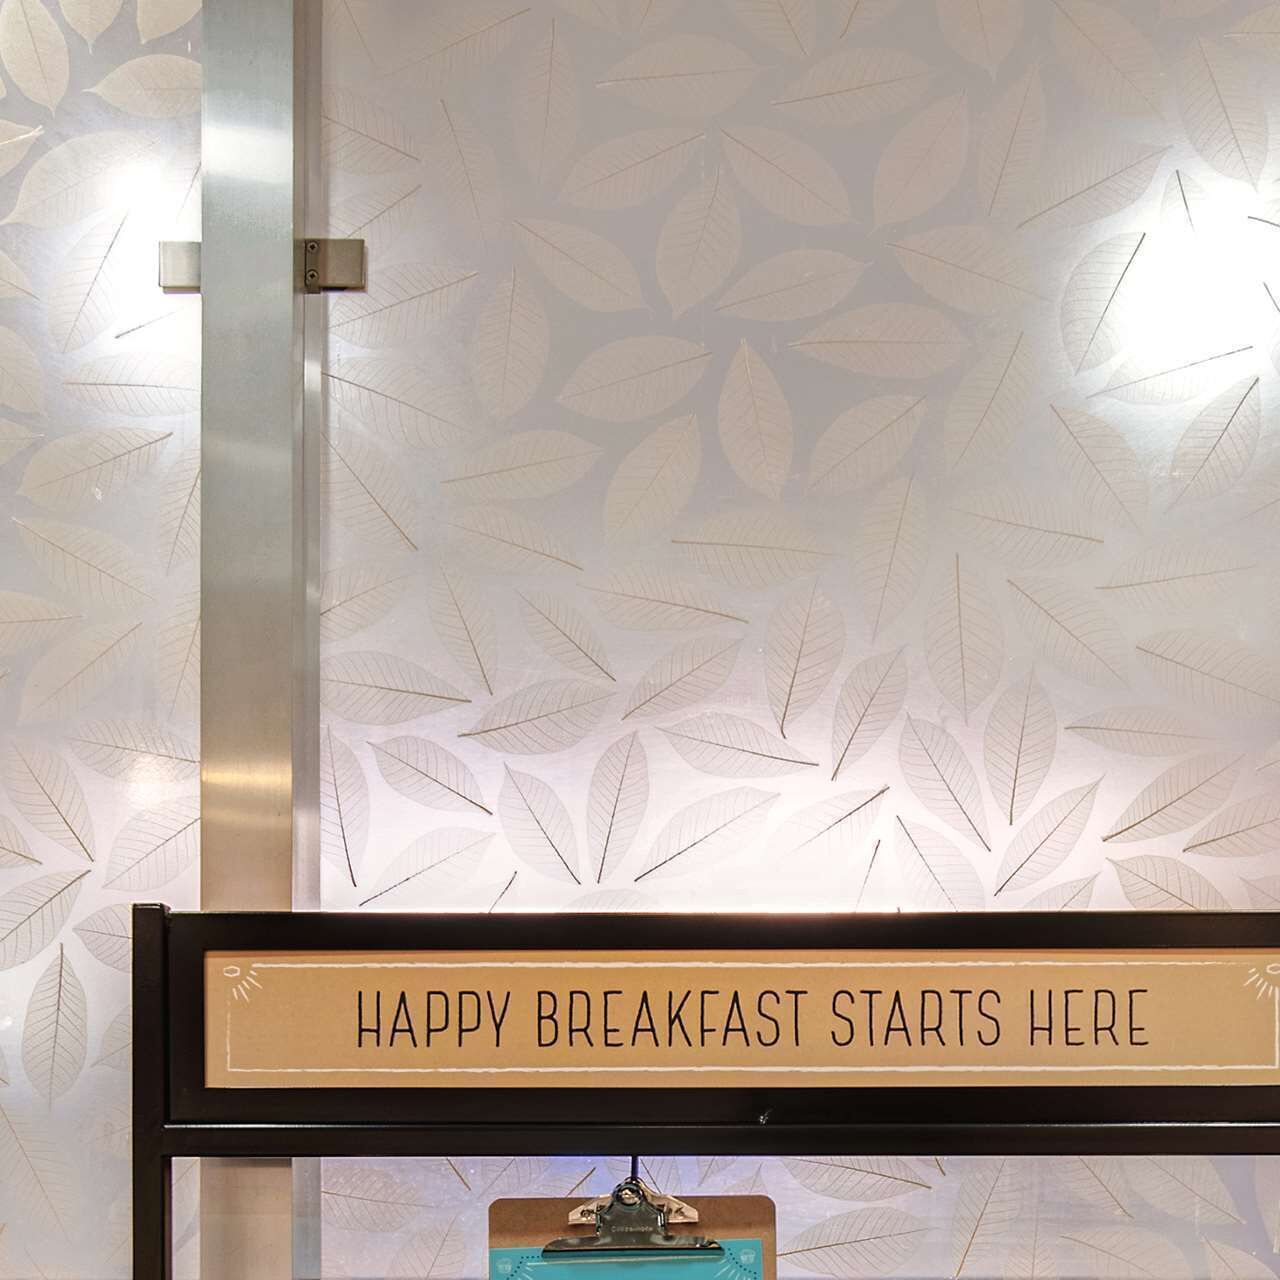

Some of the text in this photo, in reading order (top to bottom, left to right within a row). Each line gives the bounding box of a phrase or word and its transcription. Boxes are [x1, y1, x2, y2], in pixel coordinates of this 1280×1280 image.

[356, 988, 1151, 1048] HAPPY BREAKFAST STARTS HERE
